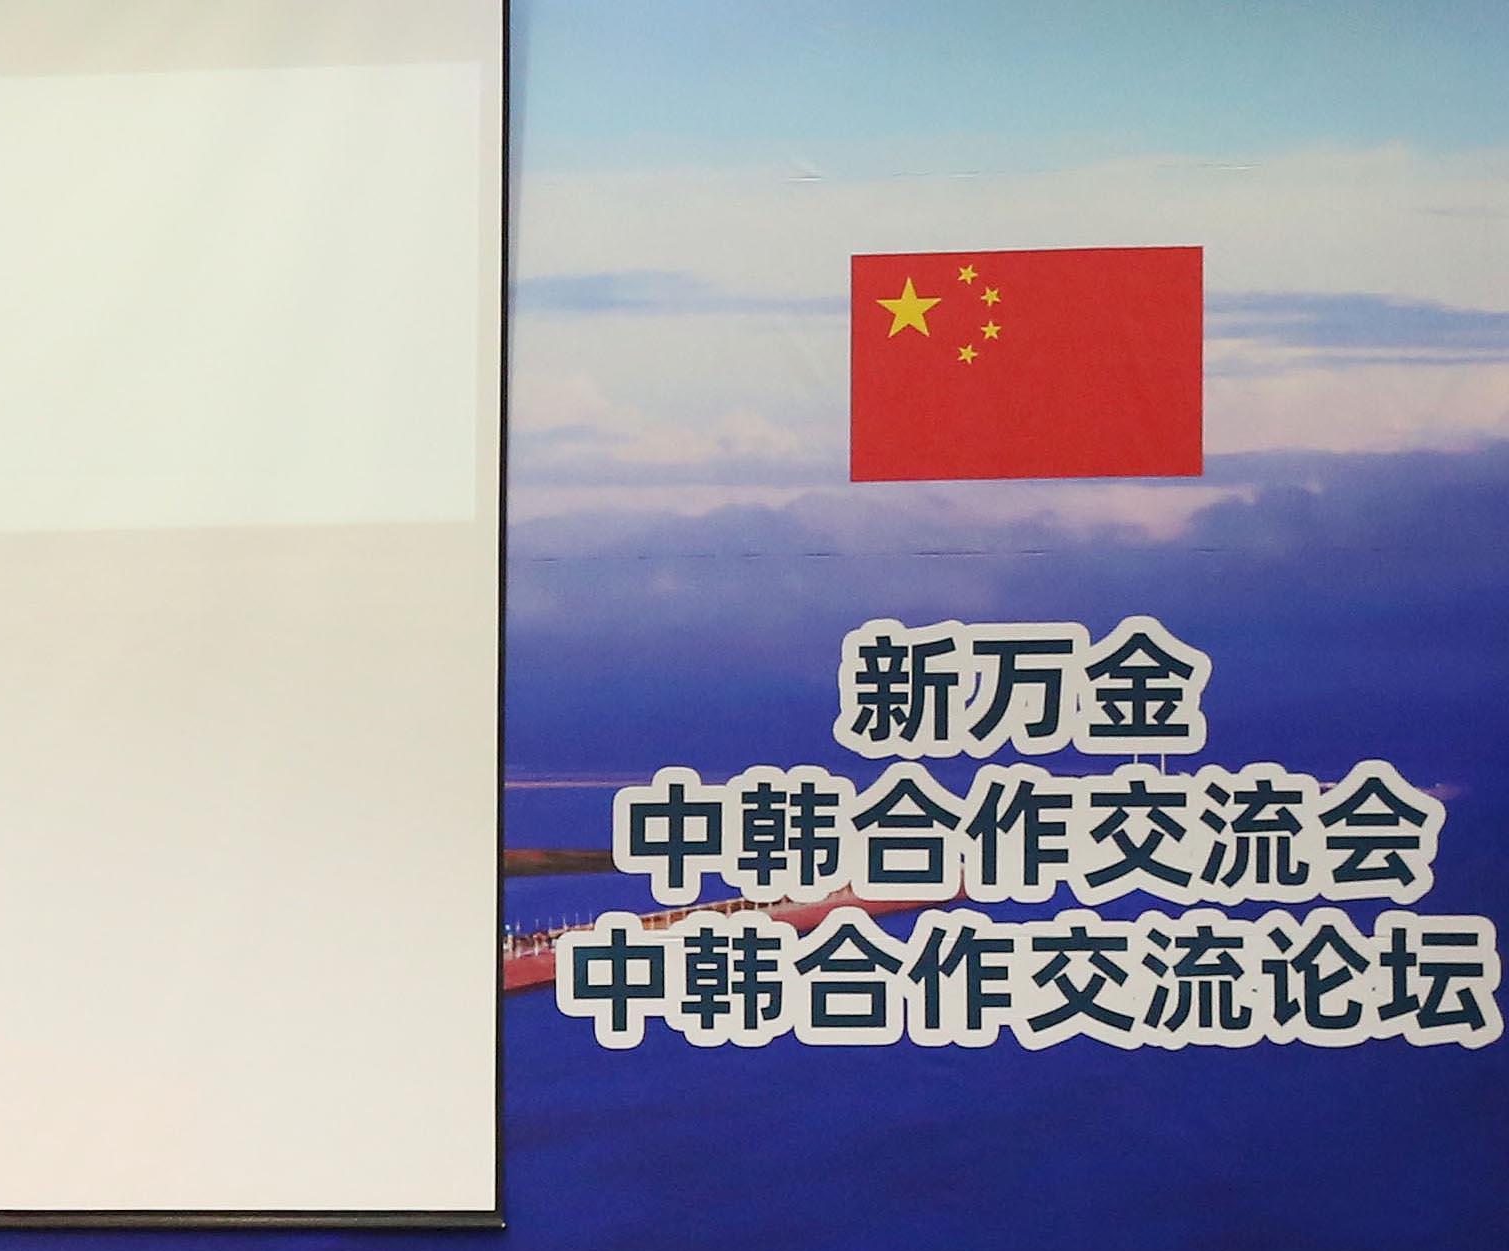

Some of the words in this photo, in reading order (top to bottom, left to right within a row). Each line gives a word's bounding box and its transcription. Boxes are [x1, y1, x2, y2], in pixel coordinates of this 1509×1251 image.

[848, 630, 1197, 744] 新万金
[626, 774, 1430, 892] 中韩合作交流会
[569, 920, 1490, 1035] 中韩合作交流论坛
